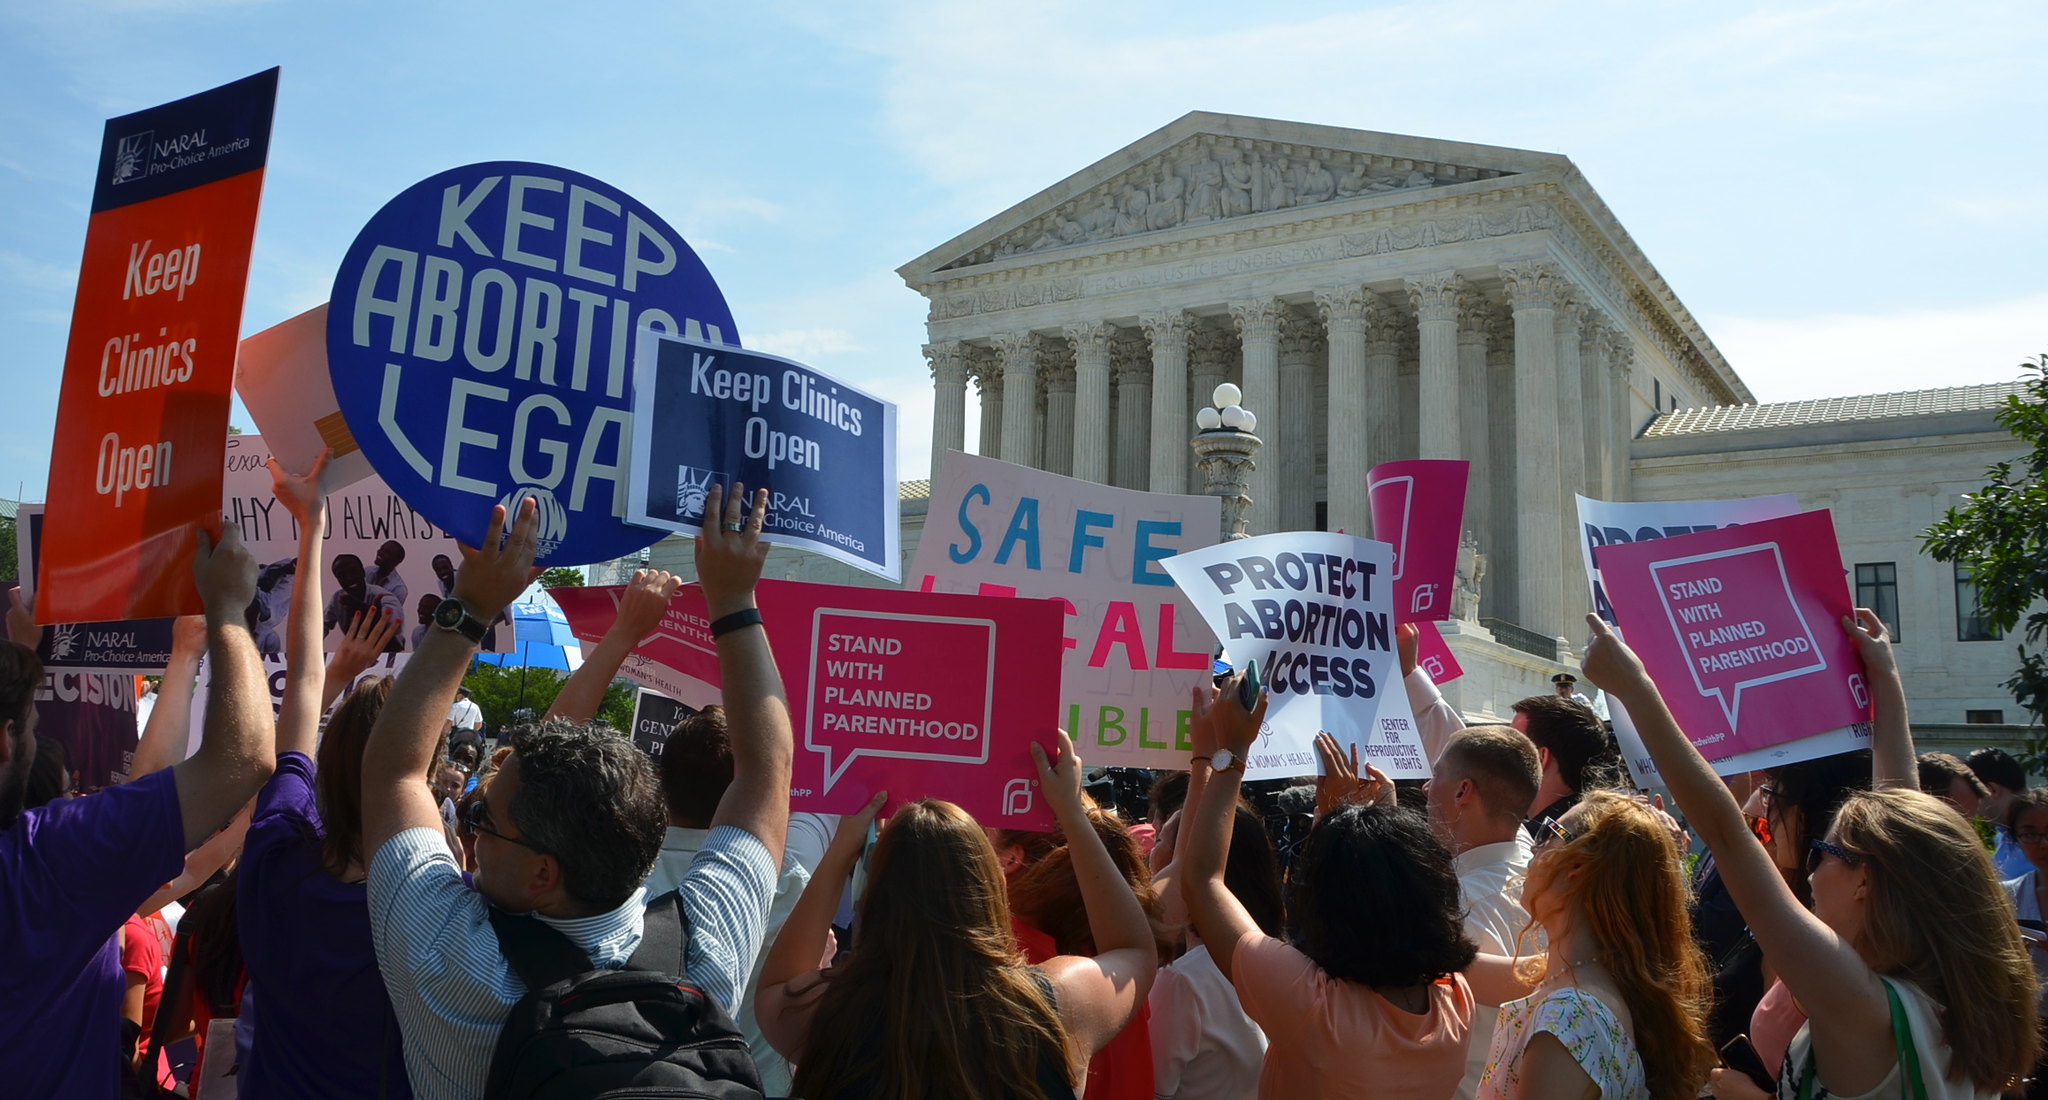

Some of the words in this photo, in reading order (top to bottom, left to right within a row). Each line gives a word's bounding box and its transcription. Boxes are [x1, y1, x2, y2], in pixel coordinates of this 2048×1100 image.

[150, 151, 206, 175] Pro-Choice
[207, 138, 250, 160] America
[154, 129, 208, 160] NARAL
[437, 175, 677, 292] KEEP
[122, 239, 201, 301] Keep
[1226, 250, 1283, 272] UNDER
[1292, 244, 1328, 262] LAW
[353, 244, 724, 398] ABORTI
[98, 327, 197, 397] Clinics
[690, 352, 771, 413] Keep
[782, 370, 863, 437] Clinics
[377, 363, 634, 518] LEGA
[744, 416, 820, 471] Open
[96, 432, 173, 508] Open
[817, 524, 865, 552] America
[948, 482, 1182, 587] SAFE
[1202, 552, 1377, 602] PROTECT
[1669, 576, 1723, 601] STAND
[1223, 598, 1391, 652] ABORTION
[1677, 602, 1723, 625] WITH
[87, 631, 137, 648] NARAL
[828, 633, 902, 656] STAND
[1689, 620, 1766, 649] PLANNED
[84, 649, 135, 662] Pro-Choice
[135, 650, 171, 663] America
[826, 659, 884, 680] WITH
[1699, 636, 1809, 674] PARENTHOOD
[654, 677, 682, 696] HEALTH
[1259, 650, 1376, 699] ACCESS
[33, 672, 136, 714] ECISION
[824, 686, 932, 711] PLANNED
[823, 712, 979, 741] PARENTHOOD
[1068, 703, 1194, 751] IBLE
[1381, 718, 1410, 731] CENTER
[1385, 731, 1401, 744] FOR
[1255, 753, 1287, 769] WOMAN'S
[1287, 751, 1315, 766] HEALTH
[1365, 744, 1419, 757] REPRODUCTIVE
[1395, 757, 1423, 770] RIGHTS
